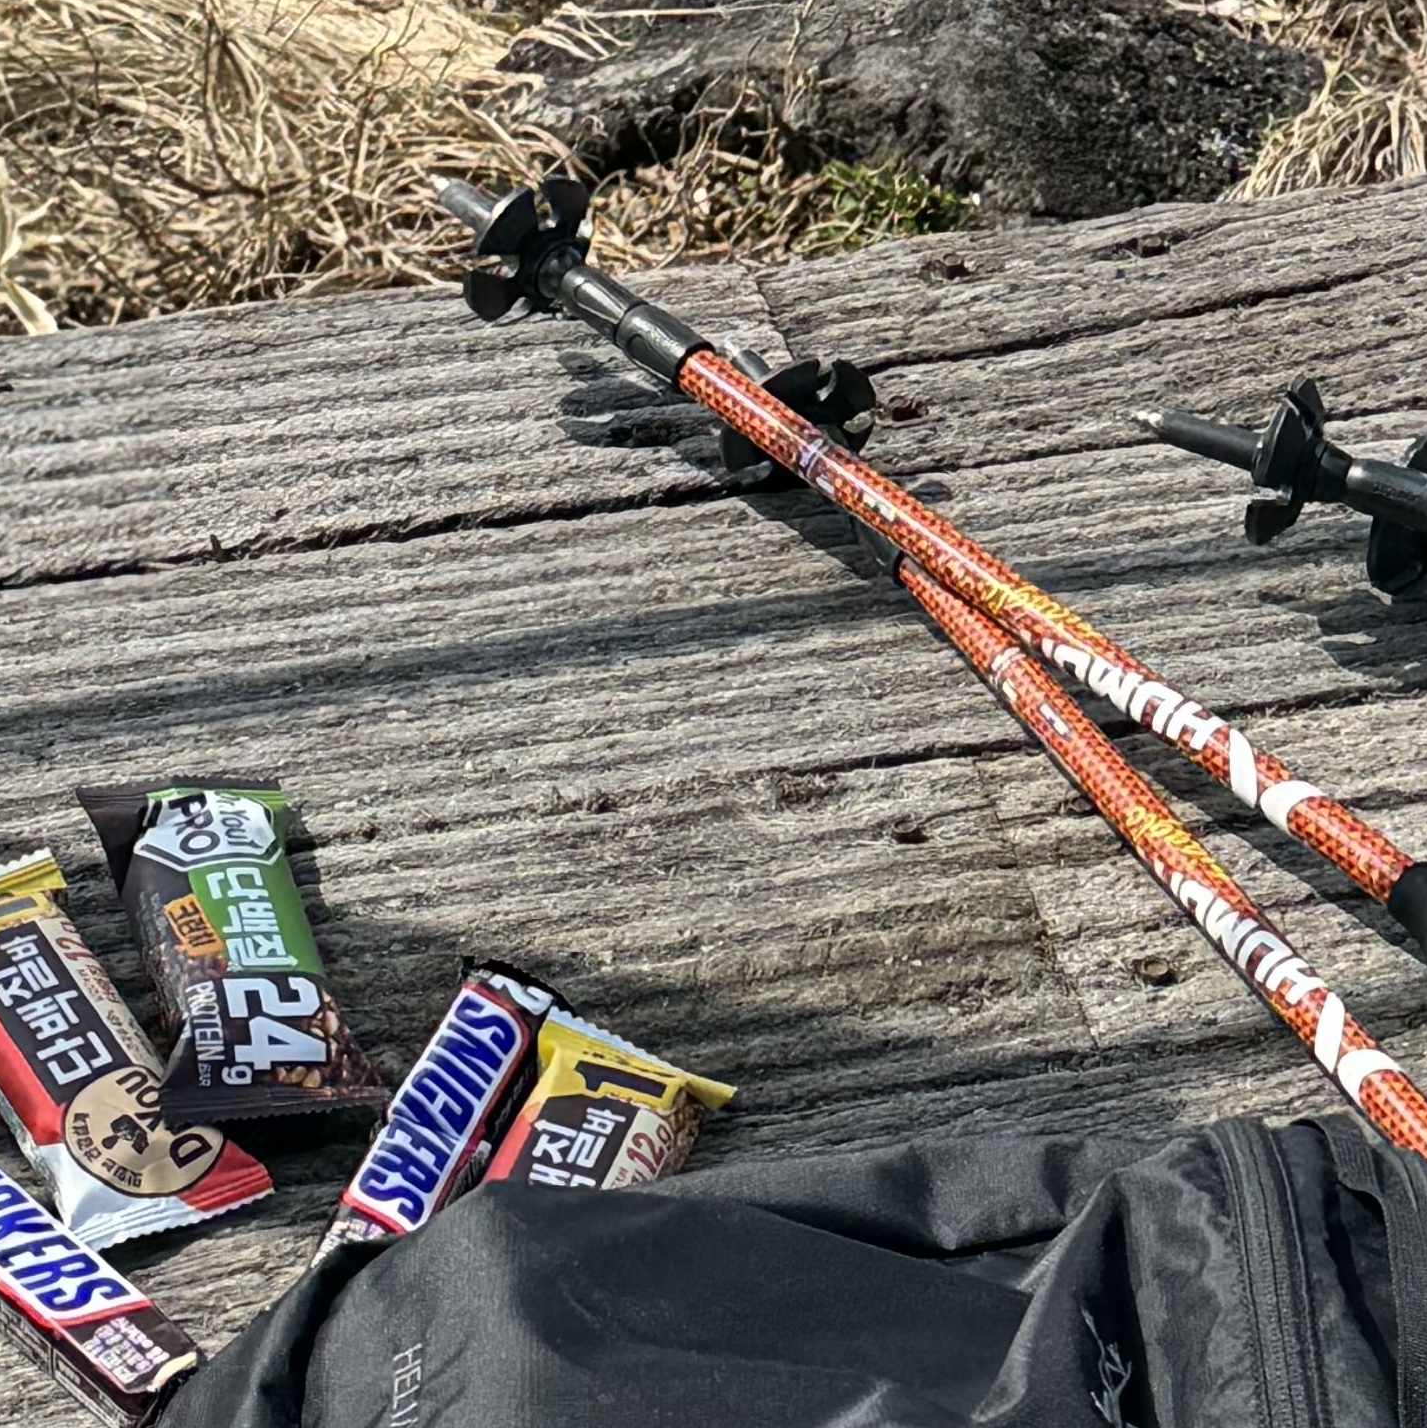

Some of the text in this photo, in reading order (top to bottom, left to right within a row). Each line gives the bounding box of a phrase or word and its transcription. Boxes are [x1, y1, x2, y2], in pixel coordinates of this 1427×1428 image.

[168, 793, 220, 855] PRO
[207, 867, 298, 968] 단백질
[185, 980, 226, 1061] PROTEIN
[358, 994, 518, 1226] SNICKERS
